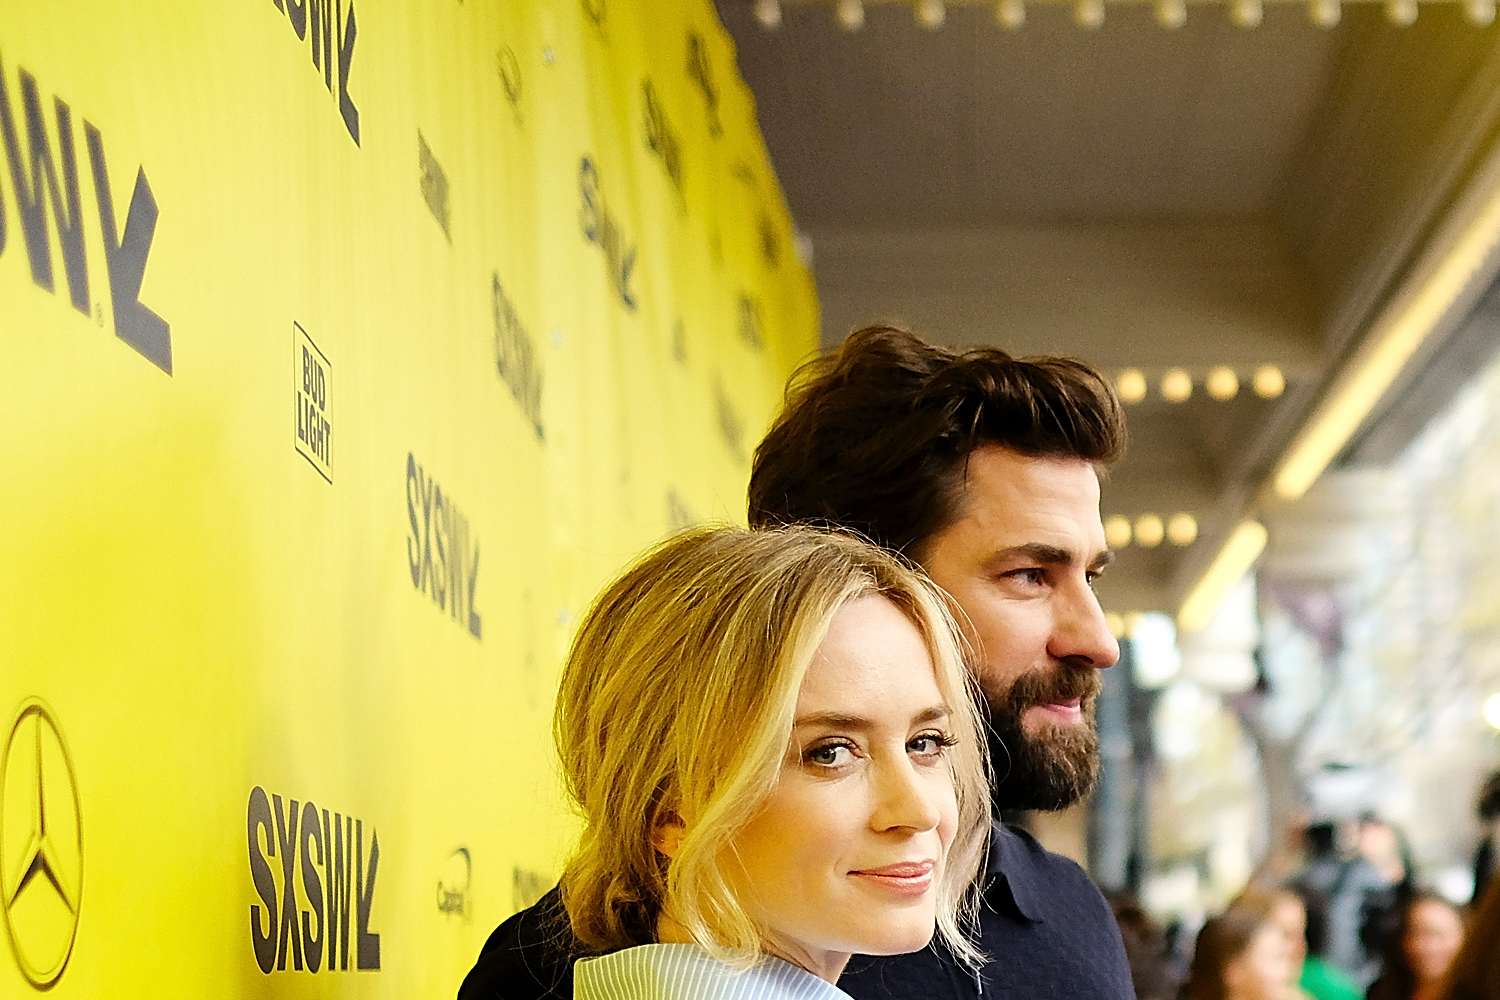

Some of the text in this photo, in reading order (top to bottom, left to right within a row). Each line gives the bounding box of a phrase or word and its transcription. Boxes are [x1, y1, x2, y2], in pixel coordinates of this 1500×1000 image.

[297, 390, 331, 467] LIGHT
[302, 344, 326, 412] BUD
[406, 450, 469, 626] SXSW
[247, 785, 353, 975] SXSW
